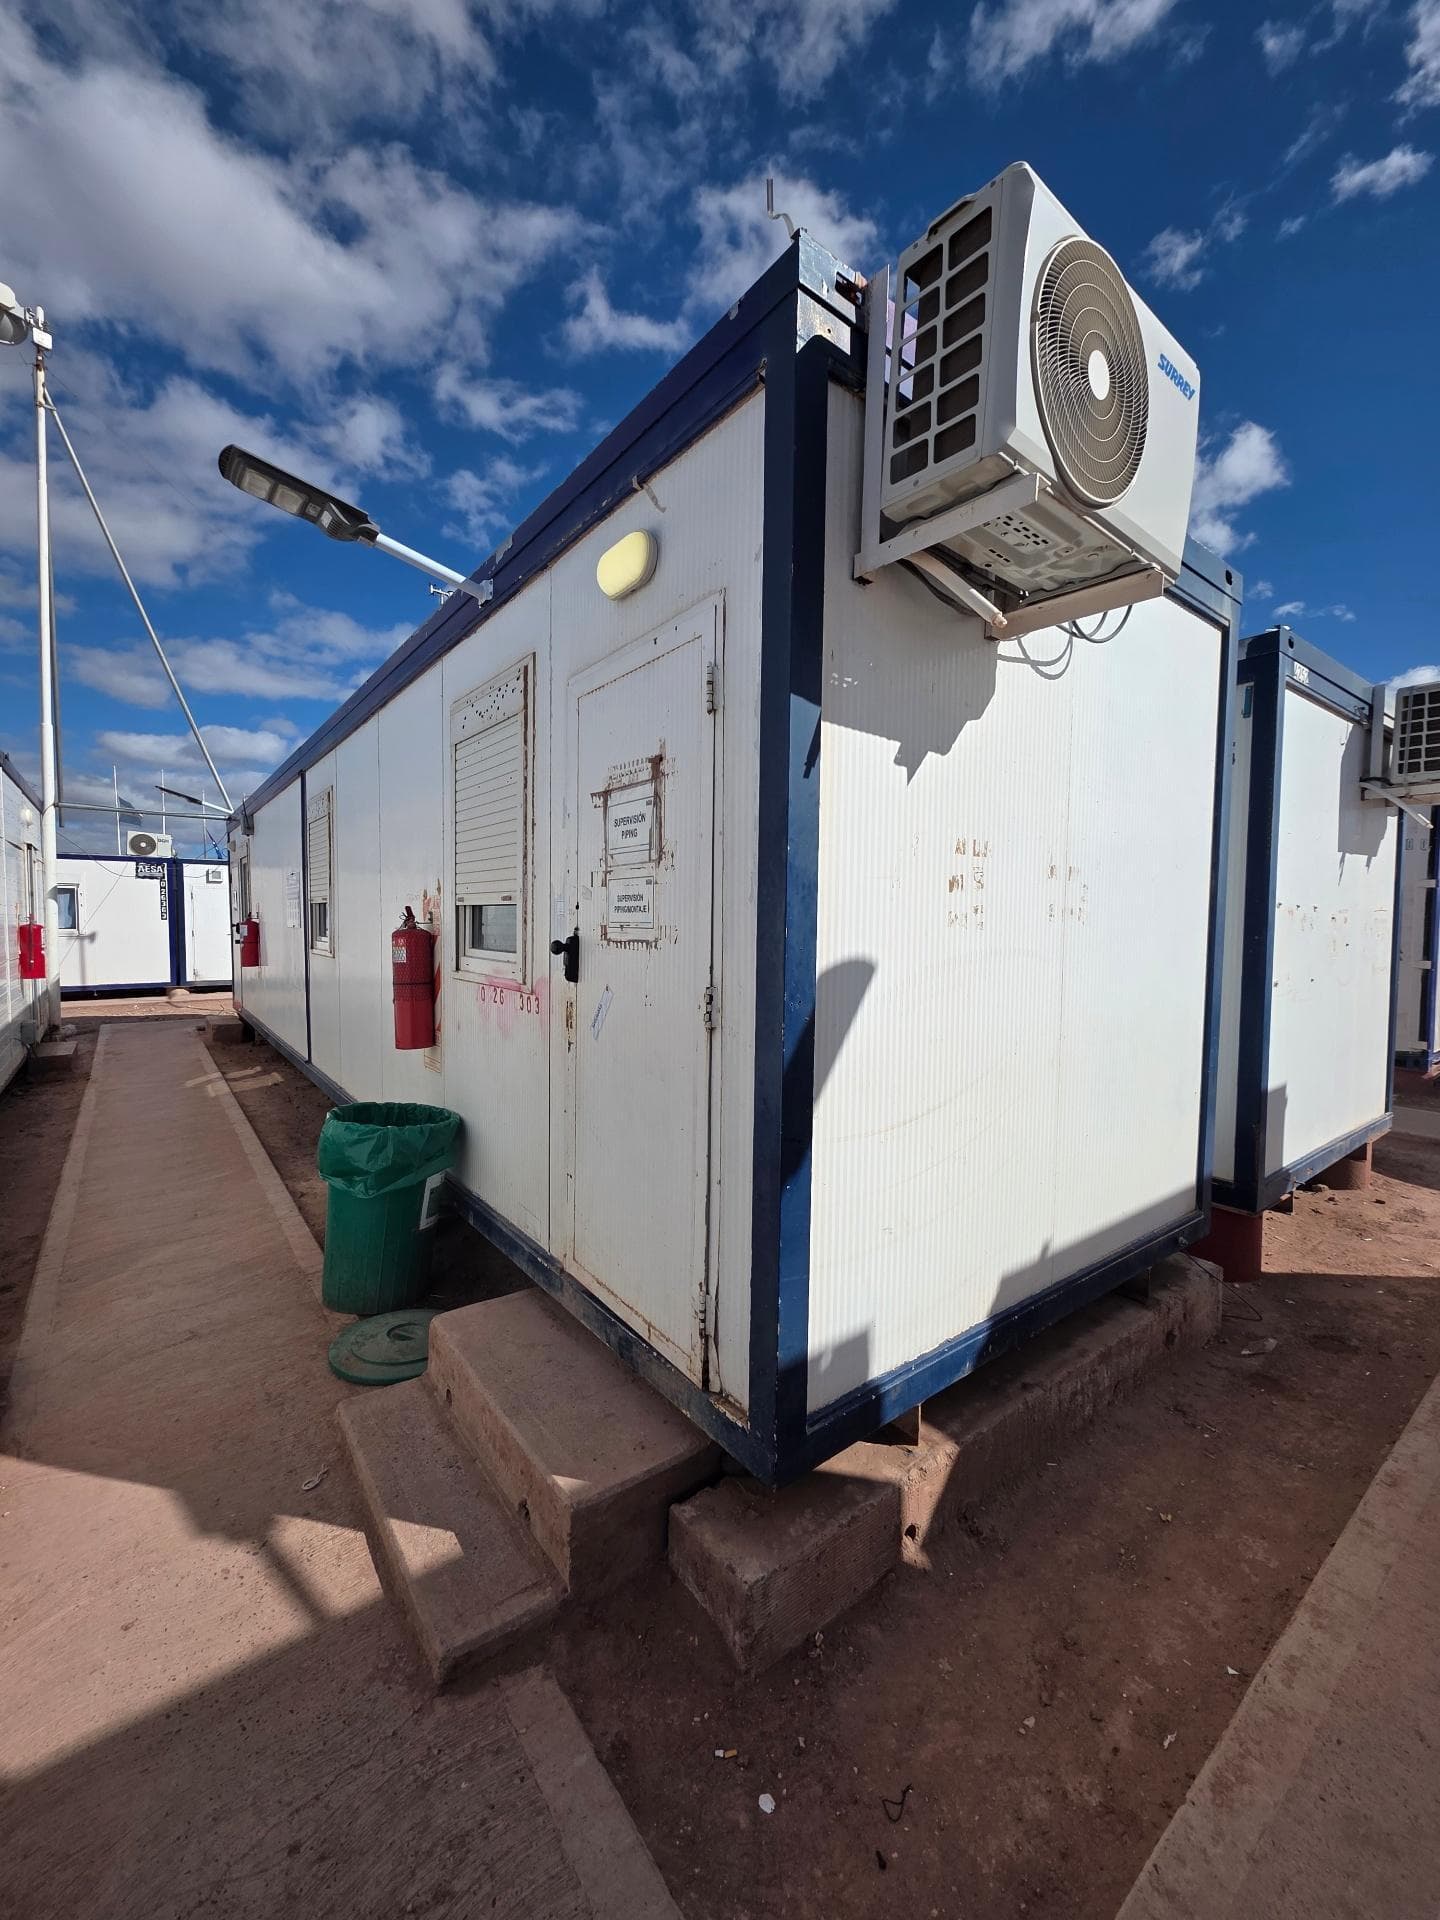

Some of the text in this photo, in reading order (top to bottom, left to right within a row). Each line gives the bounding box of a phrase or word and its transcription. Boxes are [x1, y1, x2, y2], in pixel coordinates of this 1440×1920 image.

[1157, 353, 1196, 401] SURREY
[614, 811, 646, 828] SUPERVISIÓN
[621, 828, 638, 840] PIPING
[137, 865, 163, 873] AESA
